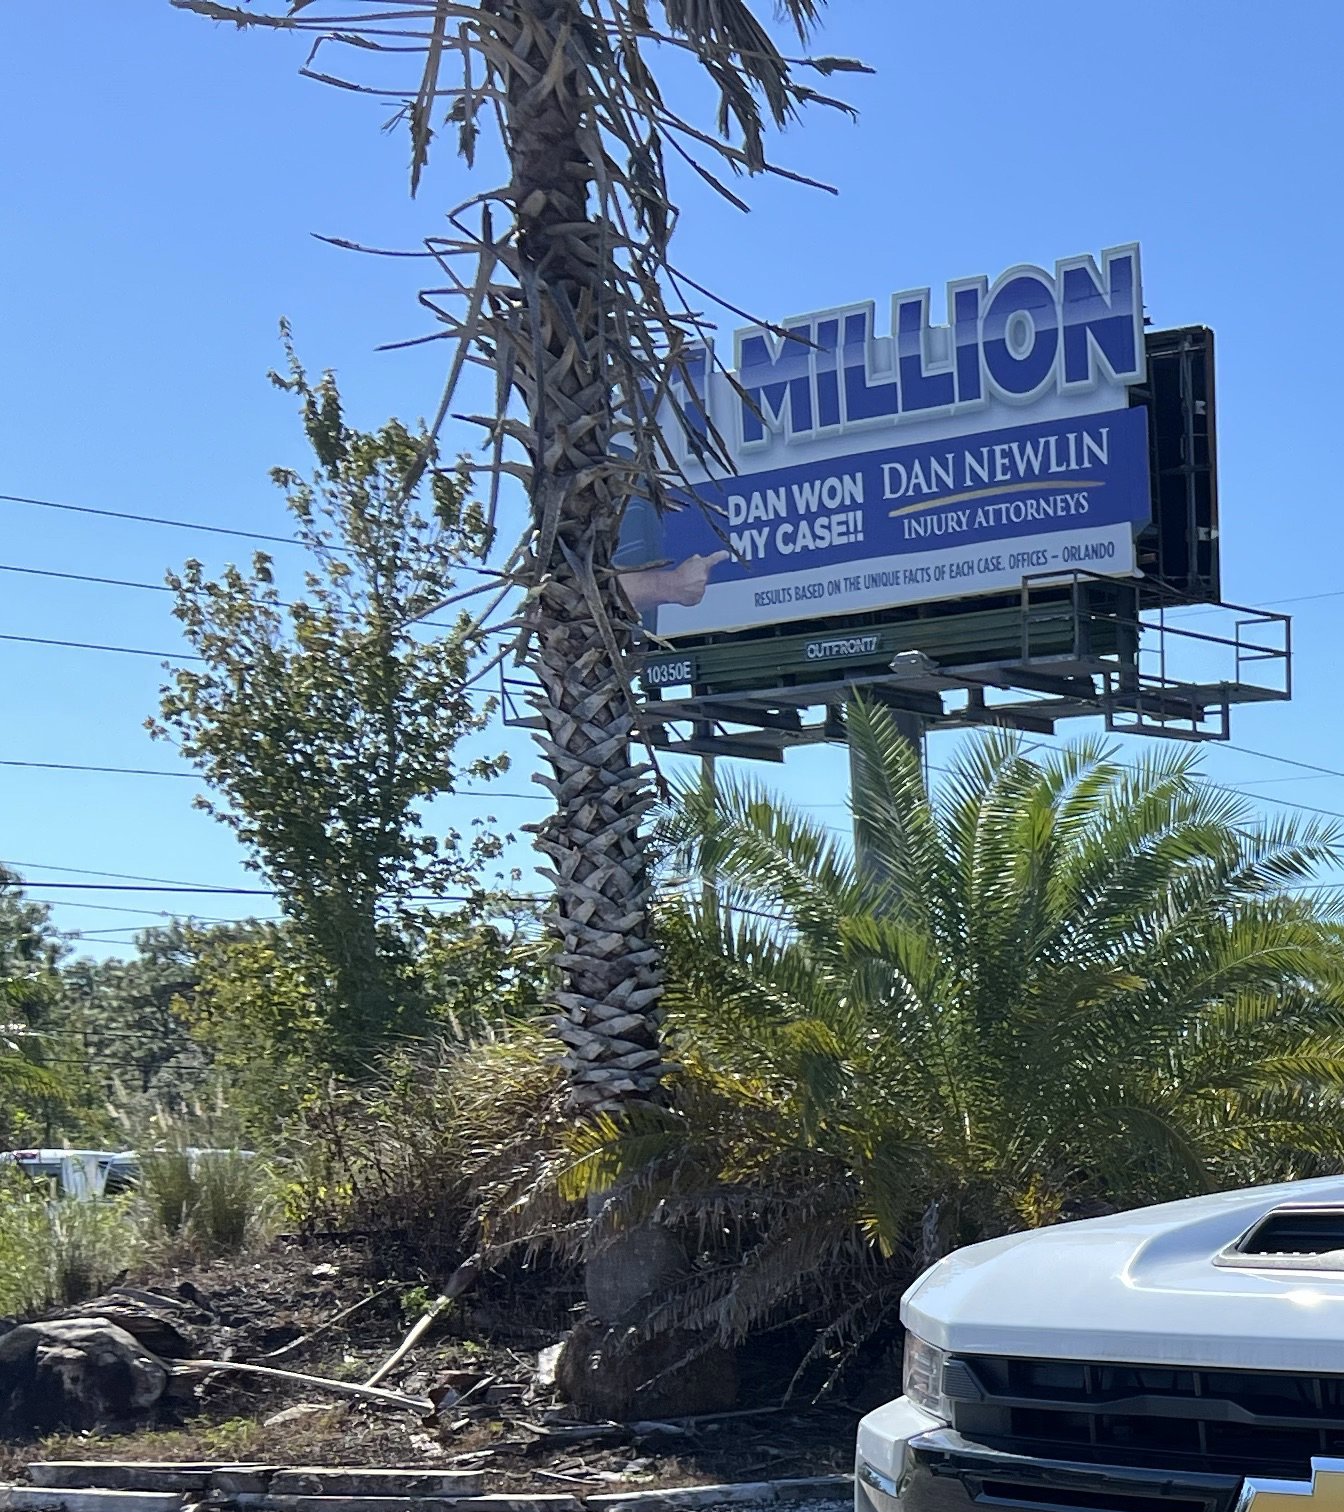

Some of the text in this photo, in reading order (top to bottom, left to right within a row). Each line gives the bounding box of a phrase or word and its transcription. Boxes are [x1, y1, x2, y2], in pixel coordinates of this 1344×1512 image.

[735, 244, 1144, 450] MILLION
[880, 428, 1110, 500] DAN NEWLIN
[727, 472, 864, 526] DAN WON
[903, 492, 1089, 539] INJURY ATTORNEYS
[729, 510, 864, 563] MY CASE!!
[754, 587, 792, 608] RESULTS
[794, 582, 825, 601] BASED
[827, 579, 841, 597] ON
[844, 575, 861, 593] THE
[863, 570, 901, 590] UNIQUE
[903, 566, 931, 585] FACTS
[933, 564, 946, 582] OF
[949, 560, 975, 579] EACH
[977, 556, 1006, 574] CASE.
[1008, 549, 1048, 569] OFFICES
[1062, 541, 1115, 563] ORLANDO
[647, 661, 691, 684] 10350E
